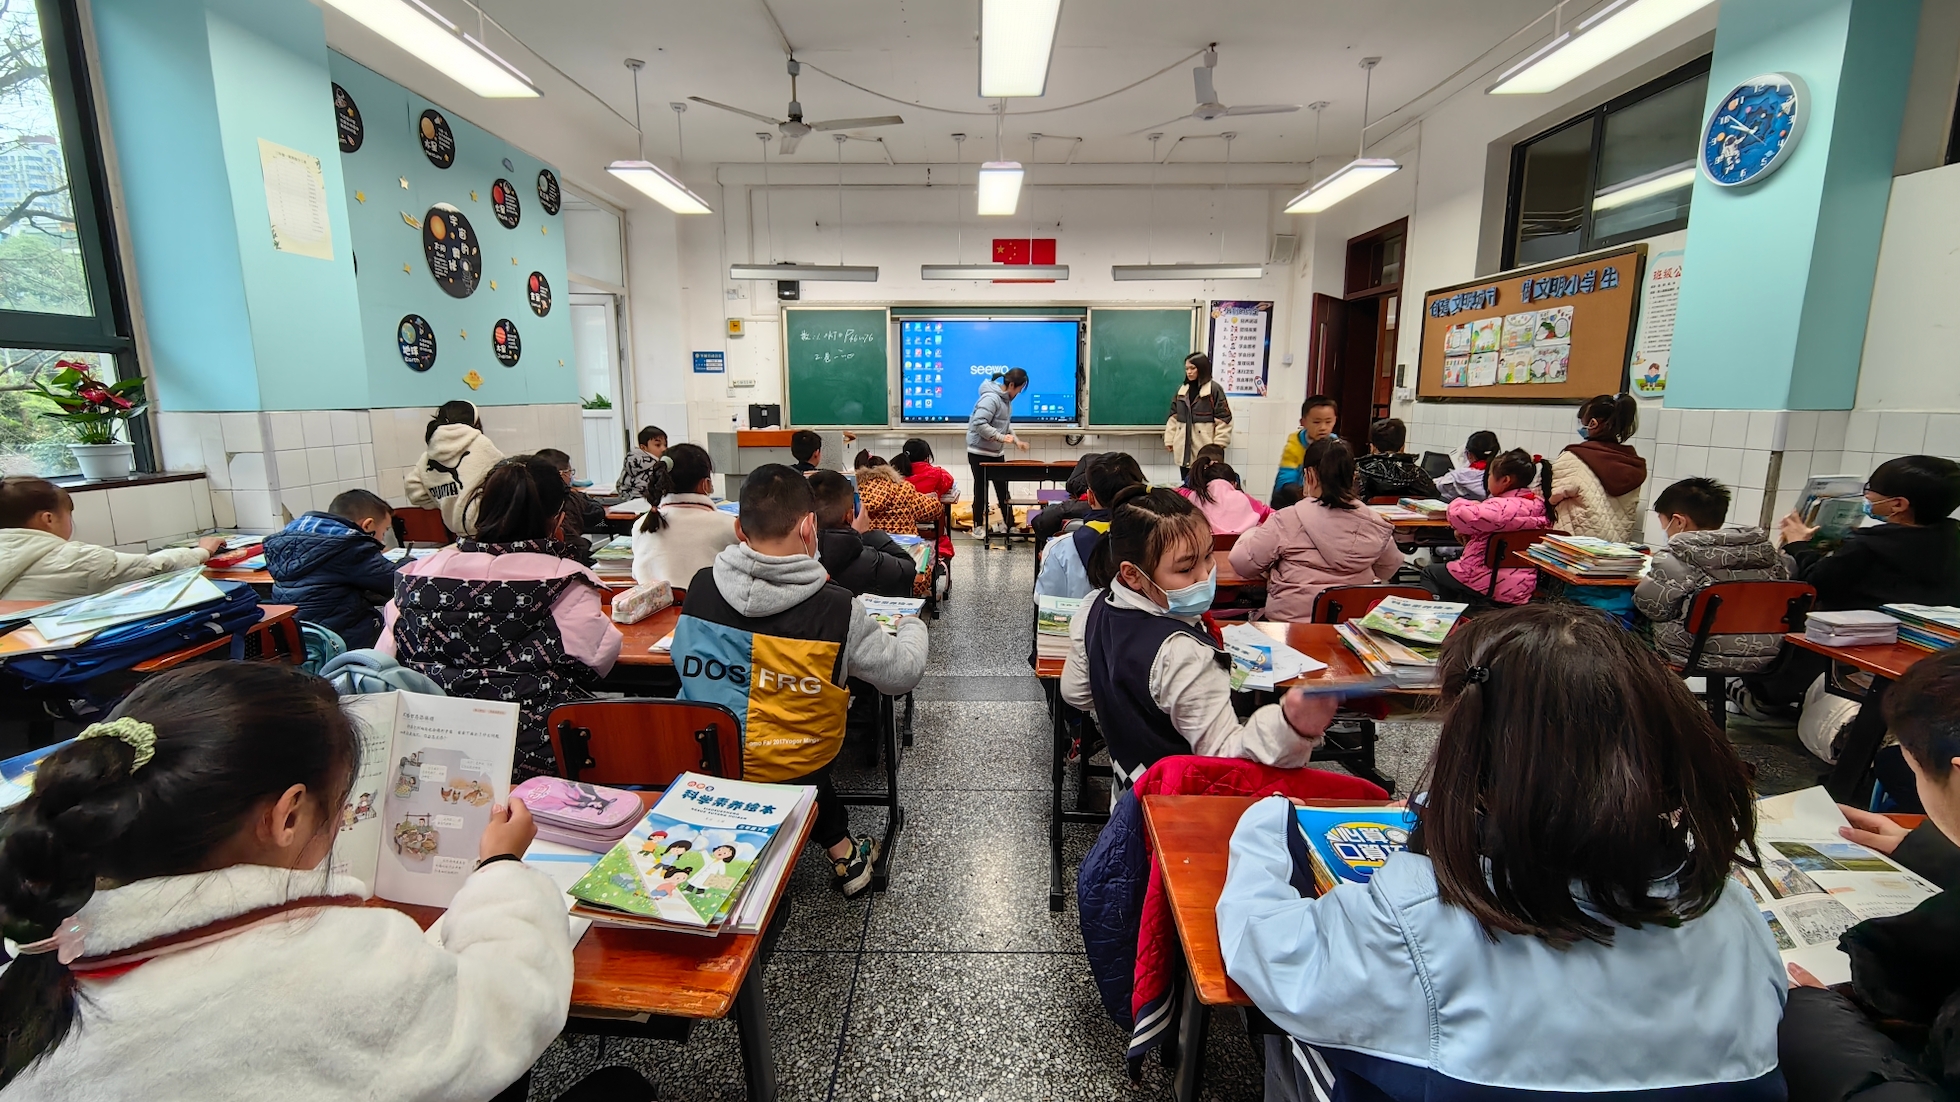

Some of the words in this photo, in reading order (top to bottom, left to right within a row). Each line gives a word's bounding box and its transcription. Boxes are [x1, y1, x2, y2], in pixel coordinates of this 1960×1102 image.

[1754, 83, 1765, 93] 12
[1429, 287, 1498, 318] 创建文明城市
[402, 345, 419, 356] 地球
[970, 364, 1009, 376] seewo
[682, 655, 746, 684] DOS
[758, 668, 822, 694] FRG
[682, 789, 776, 815] 科学素养绘本
